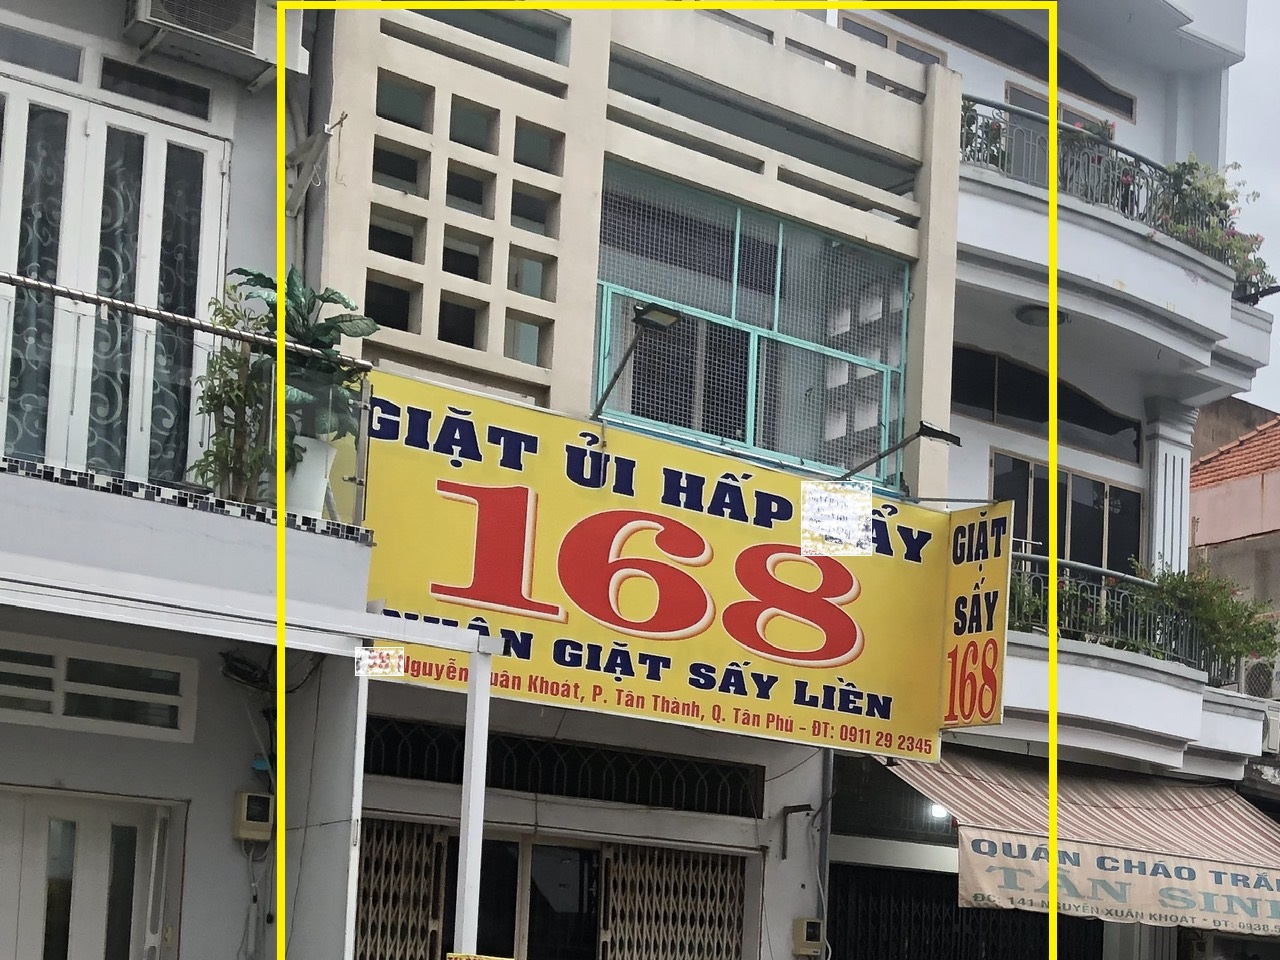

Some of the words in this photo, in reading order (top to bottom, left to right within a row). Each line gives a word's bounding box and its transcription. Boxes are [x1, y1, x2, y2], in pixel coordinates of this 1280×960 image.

[369, 396, 539, 471] GIẶT
[565, 431, 637, 497] ỦI
[661, 467, 793, 529] HẤP
[430, 479, 864, 668] 168
[952, 511, 1007, 572] GIẶT
[953, 577, 998, 636] SẤY
[489, 671, 521, 691] uân
[528, 674, 585, 704] Khoát,
[592, 685, 607, 704] P.
[616, 688, 645, 710] Tân
[652, 694, 705, 722] Thành,
[712, 703, 726, 722] Q.
[733, 707, 760, 728] Tân
[765, 713, 793, 733] Phú
[812, 720, 834, 739] ĐT:
[840, 724, 870, 746] 0911
[875, 731, 892, 749] 29
[897, 734, 932, 755] 2345
[553, 638, 671, 682] GIẶT
[688, 661, 778, 700] SẤY
[793, 677, 893, 720] LIỀN
[944, 638, 998, 725] 168
[971, 838, 1080, 867] QUÁN
[1096, 855, 1196, 881] CHÁO
[985, 865, 1132, 903] TÂN
[1008, 896, 1034, 907] 141
[1105, 908, 1144, 920] XUÂN
[1149, 912, 1197, 924] KHOÁT
